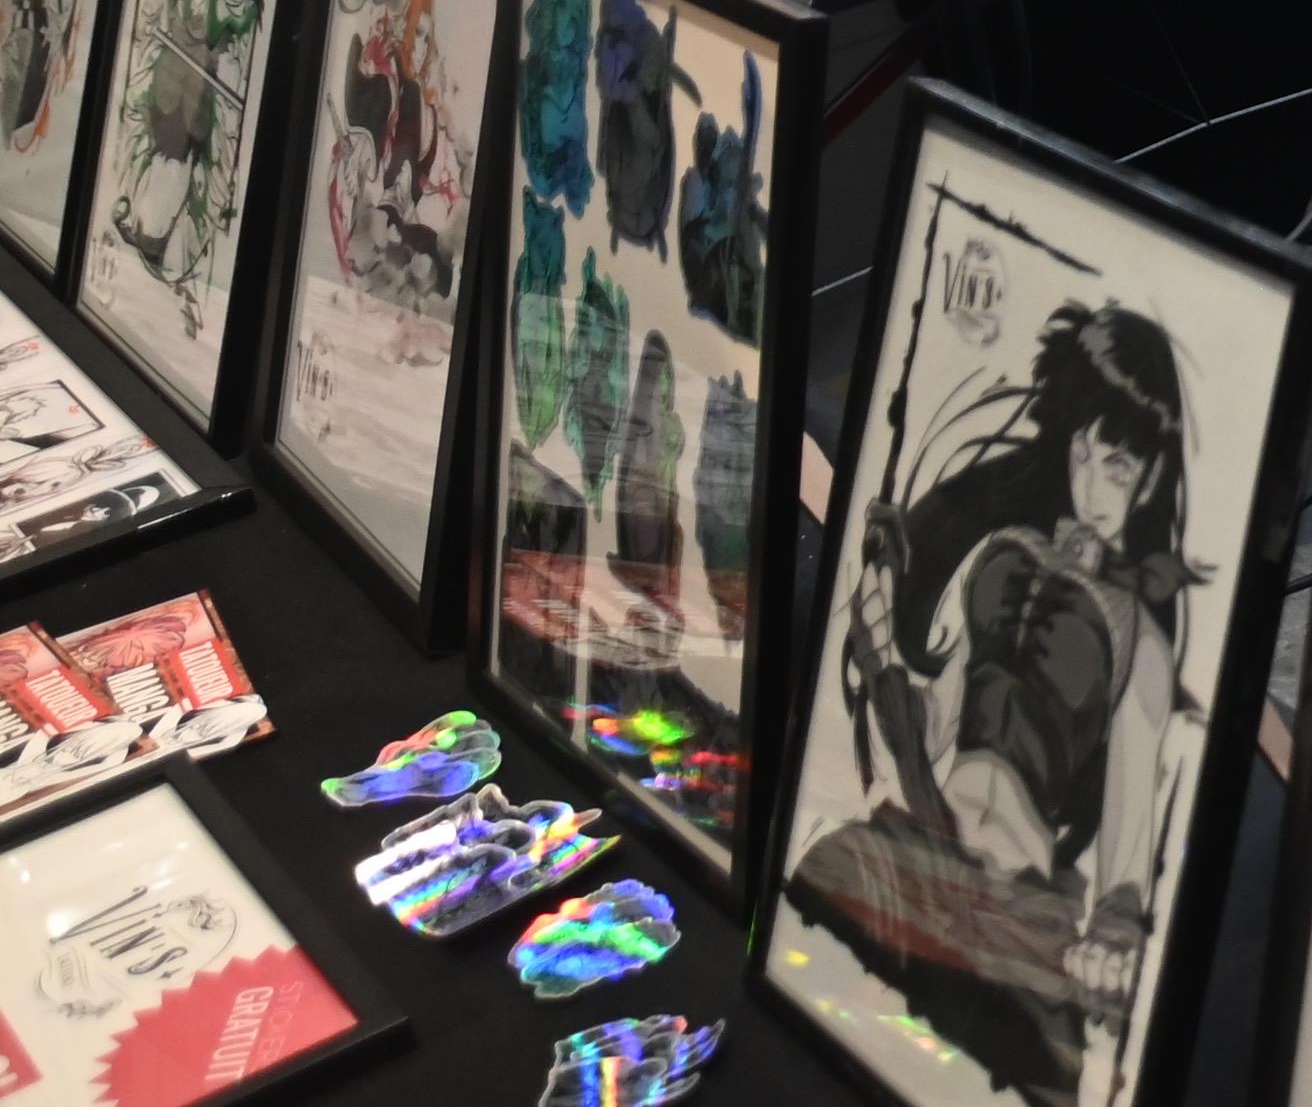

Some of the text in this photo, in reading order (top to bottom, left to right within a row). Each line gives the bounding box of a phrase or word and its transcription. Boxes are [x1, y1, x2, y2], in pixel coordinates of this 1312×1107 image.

[25, 669, 98, 729] TATOUEUR
[178, 641, 233, 704] TATOUEUR
[204, 985, 274, 1081] GRATUIT
